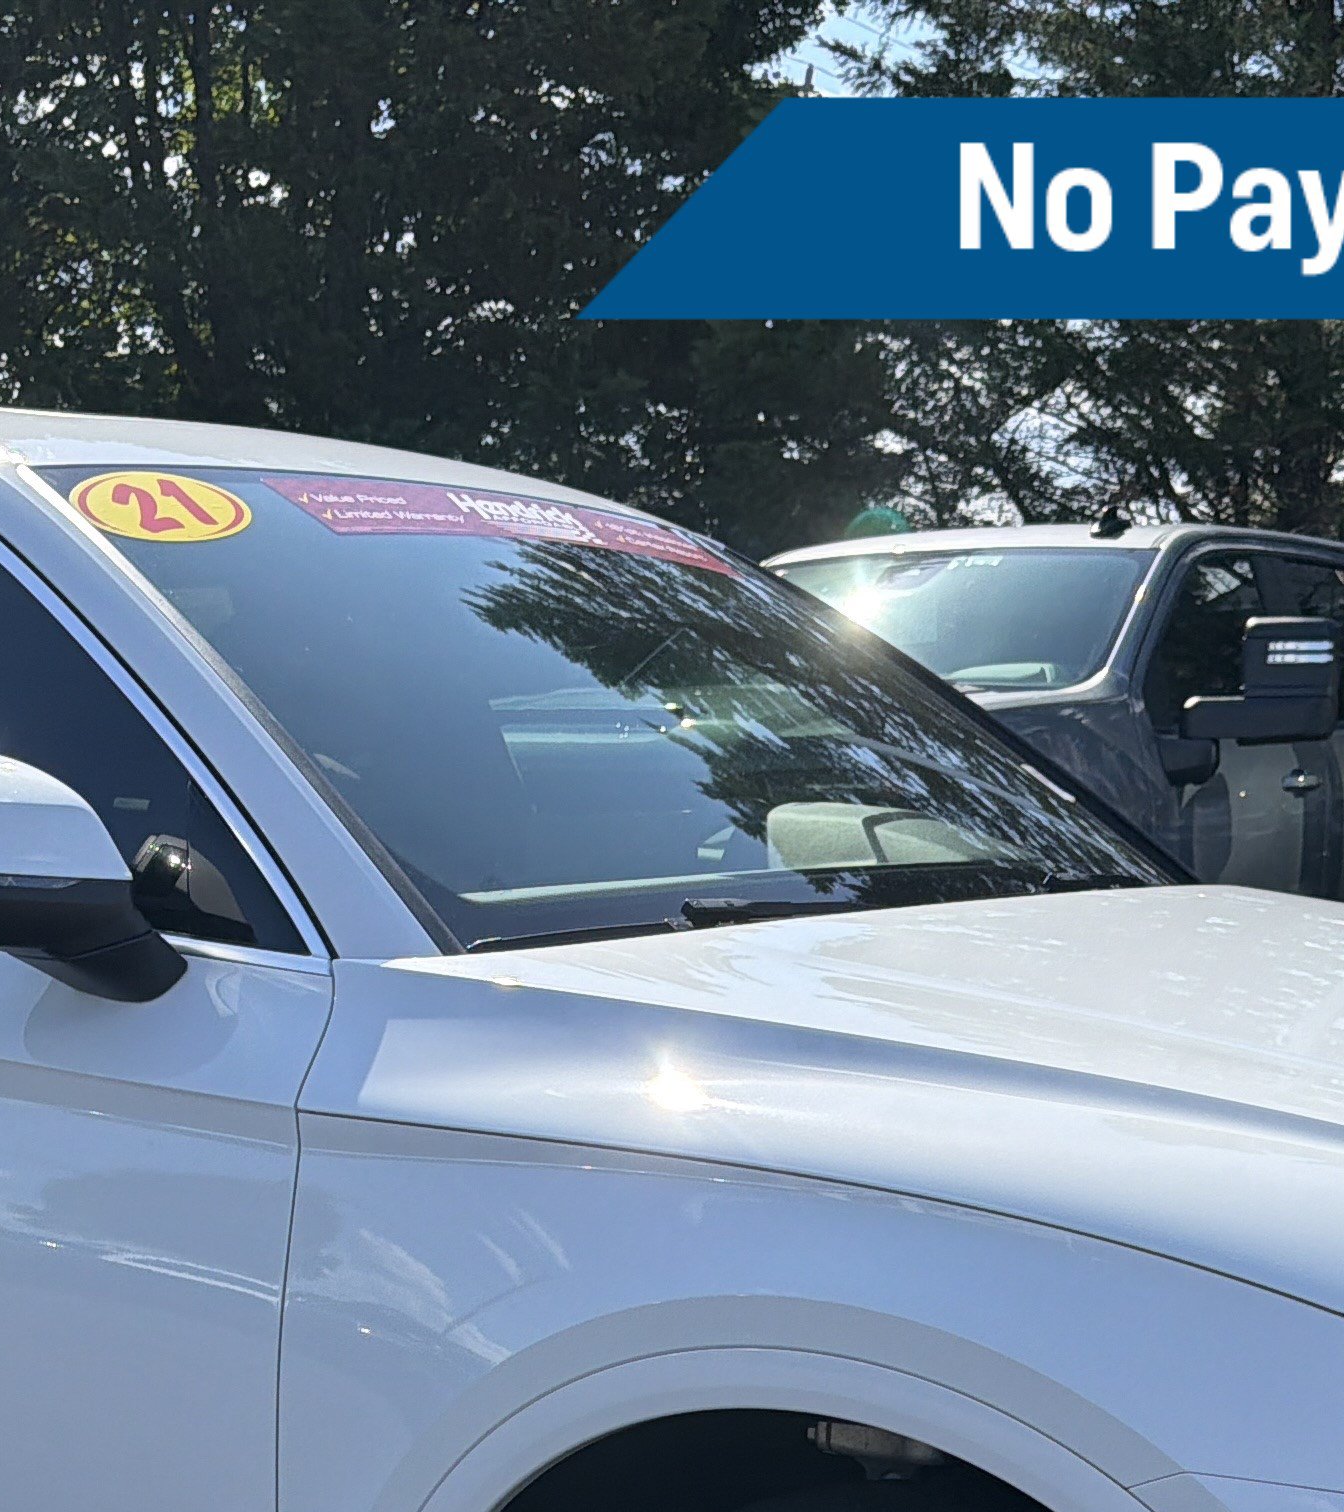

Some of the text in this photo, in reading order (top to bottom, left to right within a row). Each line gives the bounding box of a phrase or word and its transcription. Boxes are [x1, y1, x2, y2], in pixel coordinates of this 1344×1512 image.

[111, 478, 220, 534] 21
[309, 493, 407, 505] Value Priced
[446, 492, 583, 526] Hendrick
[333, 509, 465, 524] Limited Warranty
